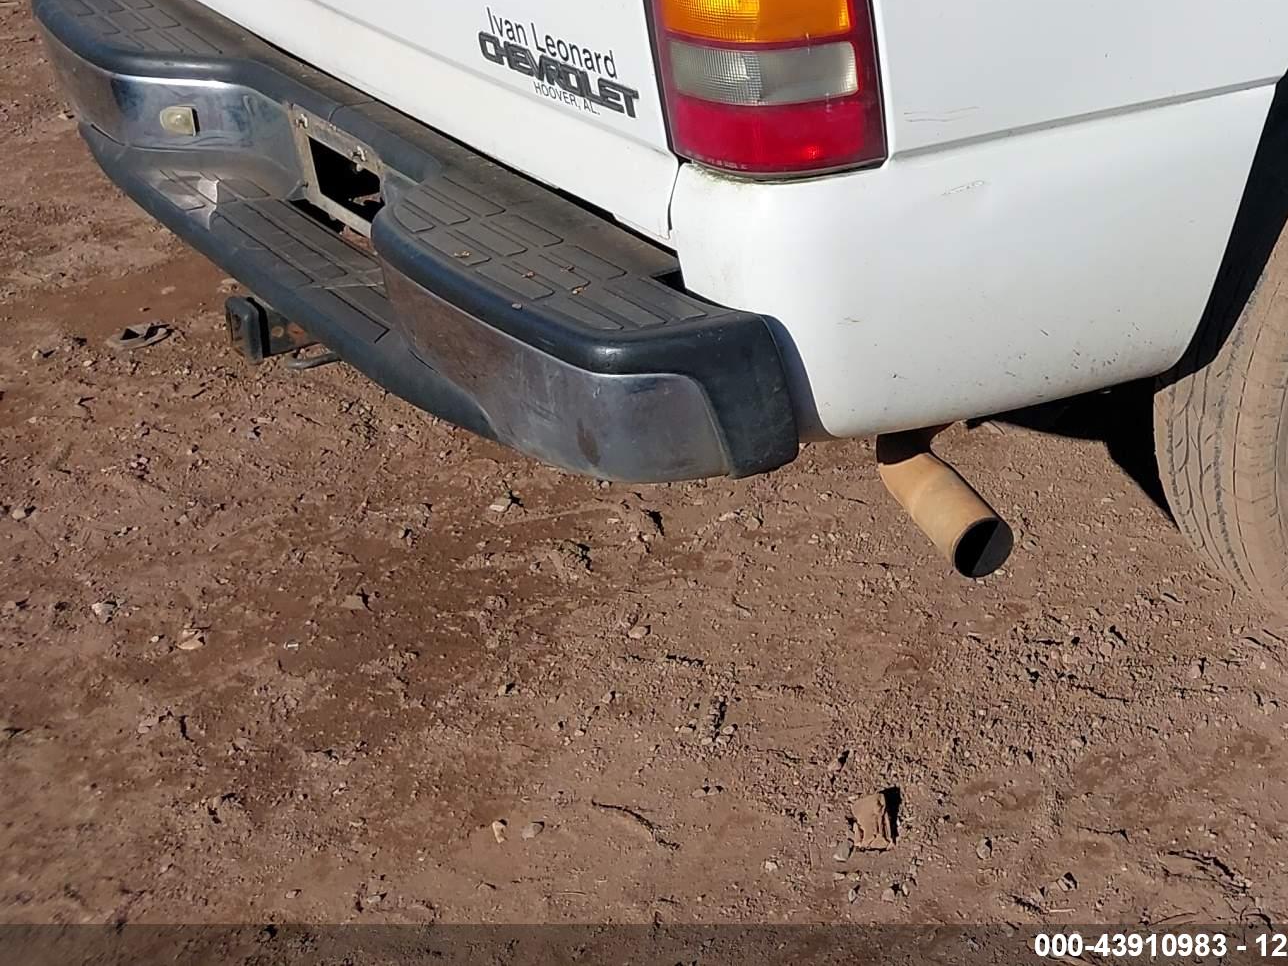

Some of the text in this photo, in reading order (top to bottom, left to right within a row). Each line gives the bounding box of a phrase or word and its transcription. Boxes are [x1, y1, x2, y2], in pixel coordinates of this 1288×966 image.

[478, 31, 639, 118] CHEVROLET
[486, 7, 617, 79] Ivan Leonard
[534, 81, 581, 111] HOOVER,
